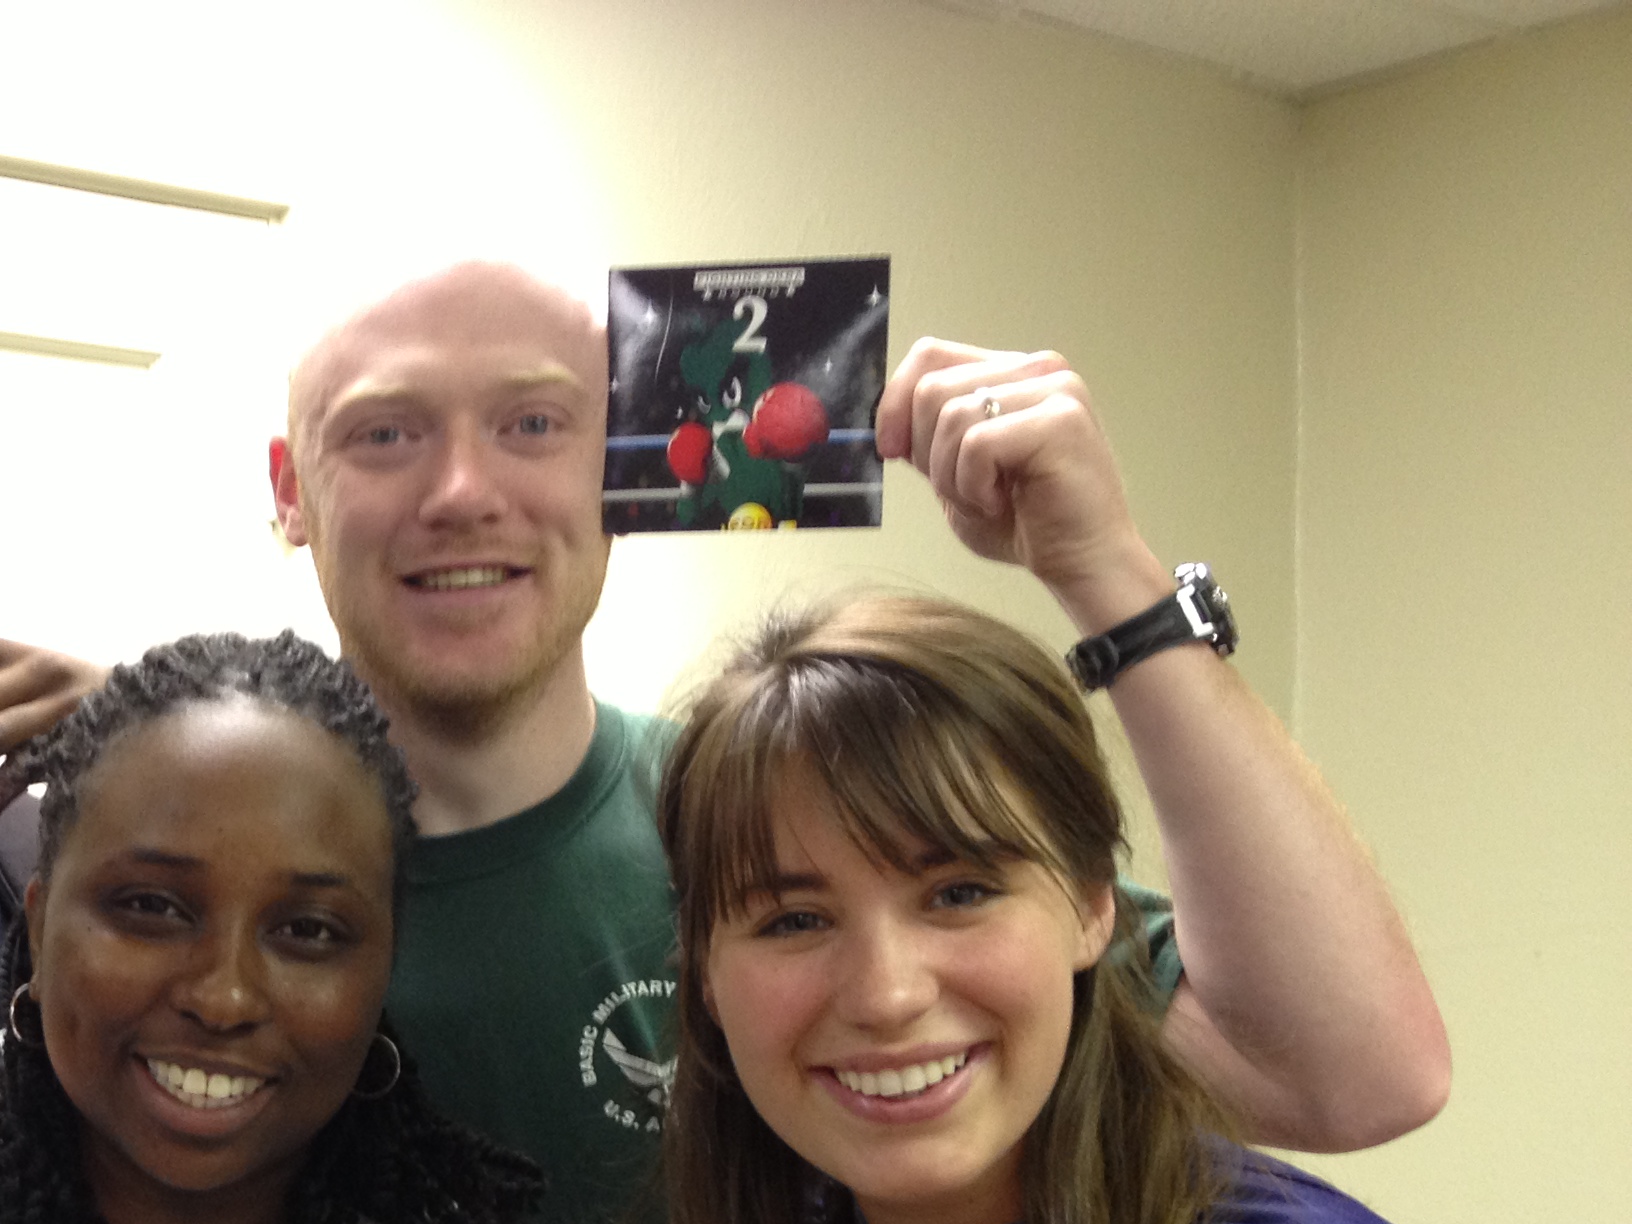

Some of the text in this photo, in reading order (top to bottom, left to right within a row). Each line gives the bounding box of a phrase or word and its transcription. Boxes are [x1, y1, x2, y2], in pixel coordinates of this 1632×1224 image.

[732, 294, 768, 354] 2
[579, 979, 677, 1088] BASIC MILITARY
